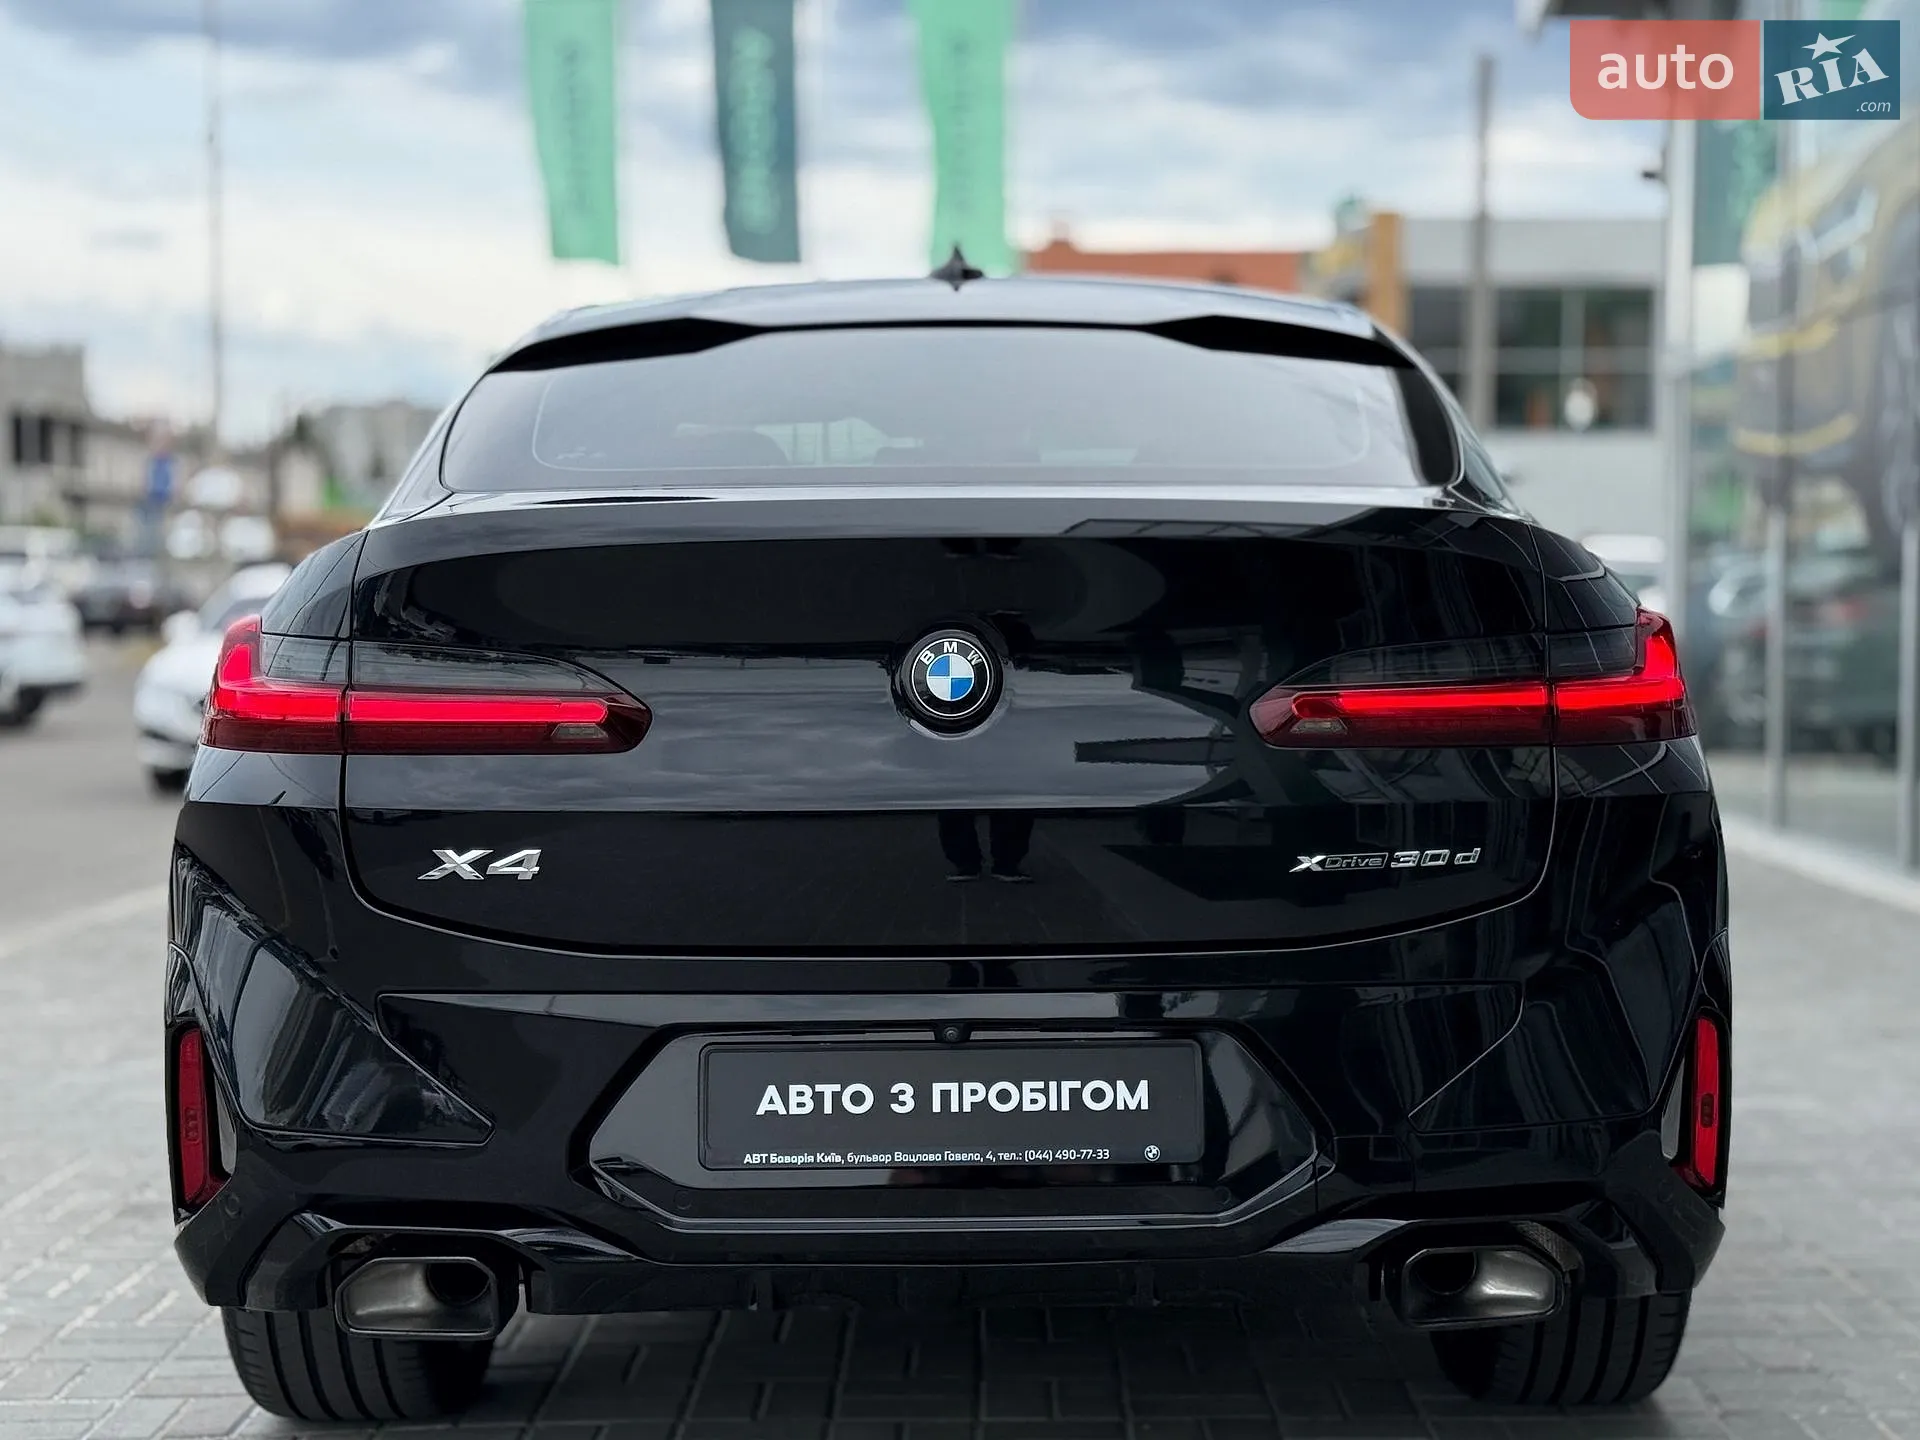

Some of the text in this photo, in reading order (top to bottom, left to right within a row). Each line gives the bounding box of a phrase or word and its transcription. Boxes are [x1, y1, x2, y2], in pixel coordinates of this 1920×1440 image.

[919, 641, 983, 666] BMW
[416, 849, 543, 881] X4
[755, 1082, 875, 1116] АВТО
[931, 1079, 1150, 1114] ПРОБІГОМ
[743, 1148, 1110, 1166] АВТ Баварія Київ, бульвар Вацлава Гавела, 4, тел.: (044) 490-77-33
